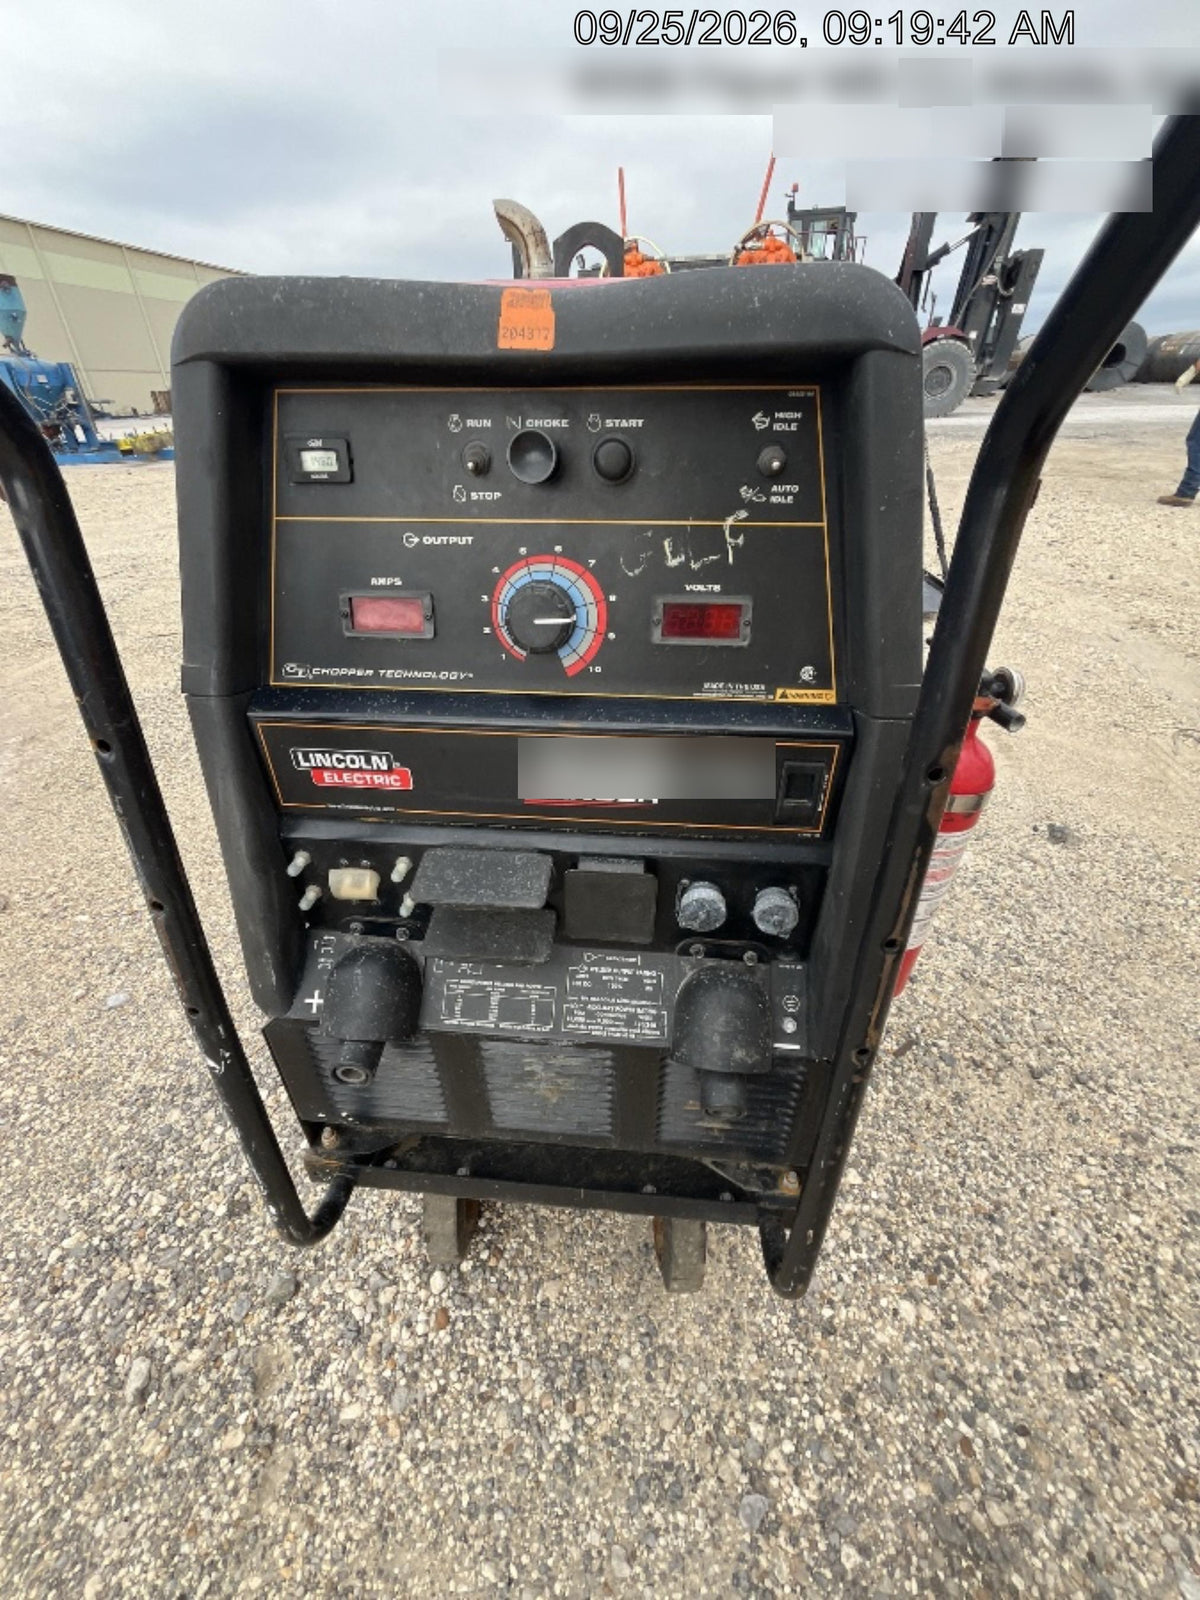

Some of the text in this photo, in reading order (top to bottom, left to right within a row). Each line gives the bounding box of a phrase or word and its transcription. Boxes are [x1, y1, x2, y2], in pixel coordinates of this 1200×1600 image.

[774, 411, 803, 419] HIGH
[466, 419, 492, 428] RUN
[525, 418, 570, 428] CHOKE
[605, 418, 645, 428] START
[772, 422, 798, 431] IDLE
[771, 484, 800, 493] AUTO
[470, 491, 502, 501] STOP
[769, 495, 794, 504] IDLE
[422, 535, 474, 546] OUTPUT
[587, 559, 597, 568] 7
[491, 566, 500, 574] 4
[370, 577, 403, 586] AMPS
[684, 584, 721, 593] VOLTS
[480, 594, 489, 602] 3
[500, 653, 506, 661] 1
[312, 667, 374, 677] CHOPPER
[377, 668, 468, 680] TECHNOLOGY
[588, 665, 602, 673] 10
[296, 750, 402, 787] LINCOLN ELECTRIC
